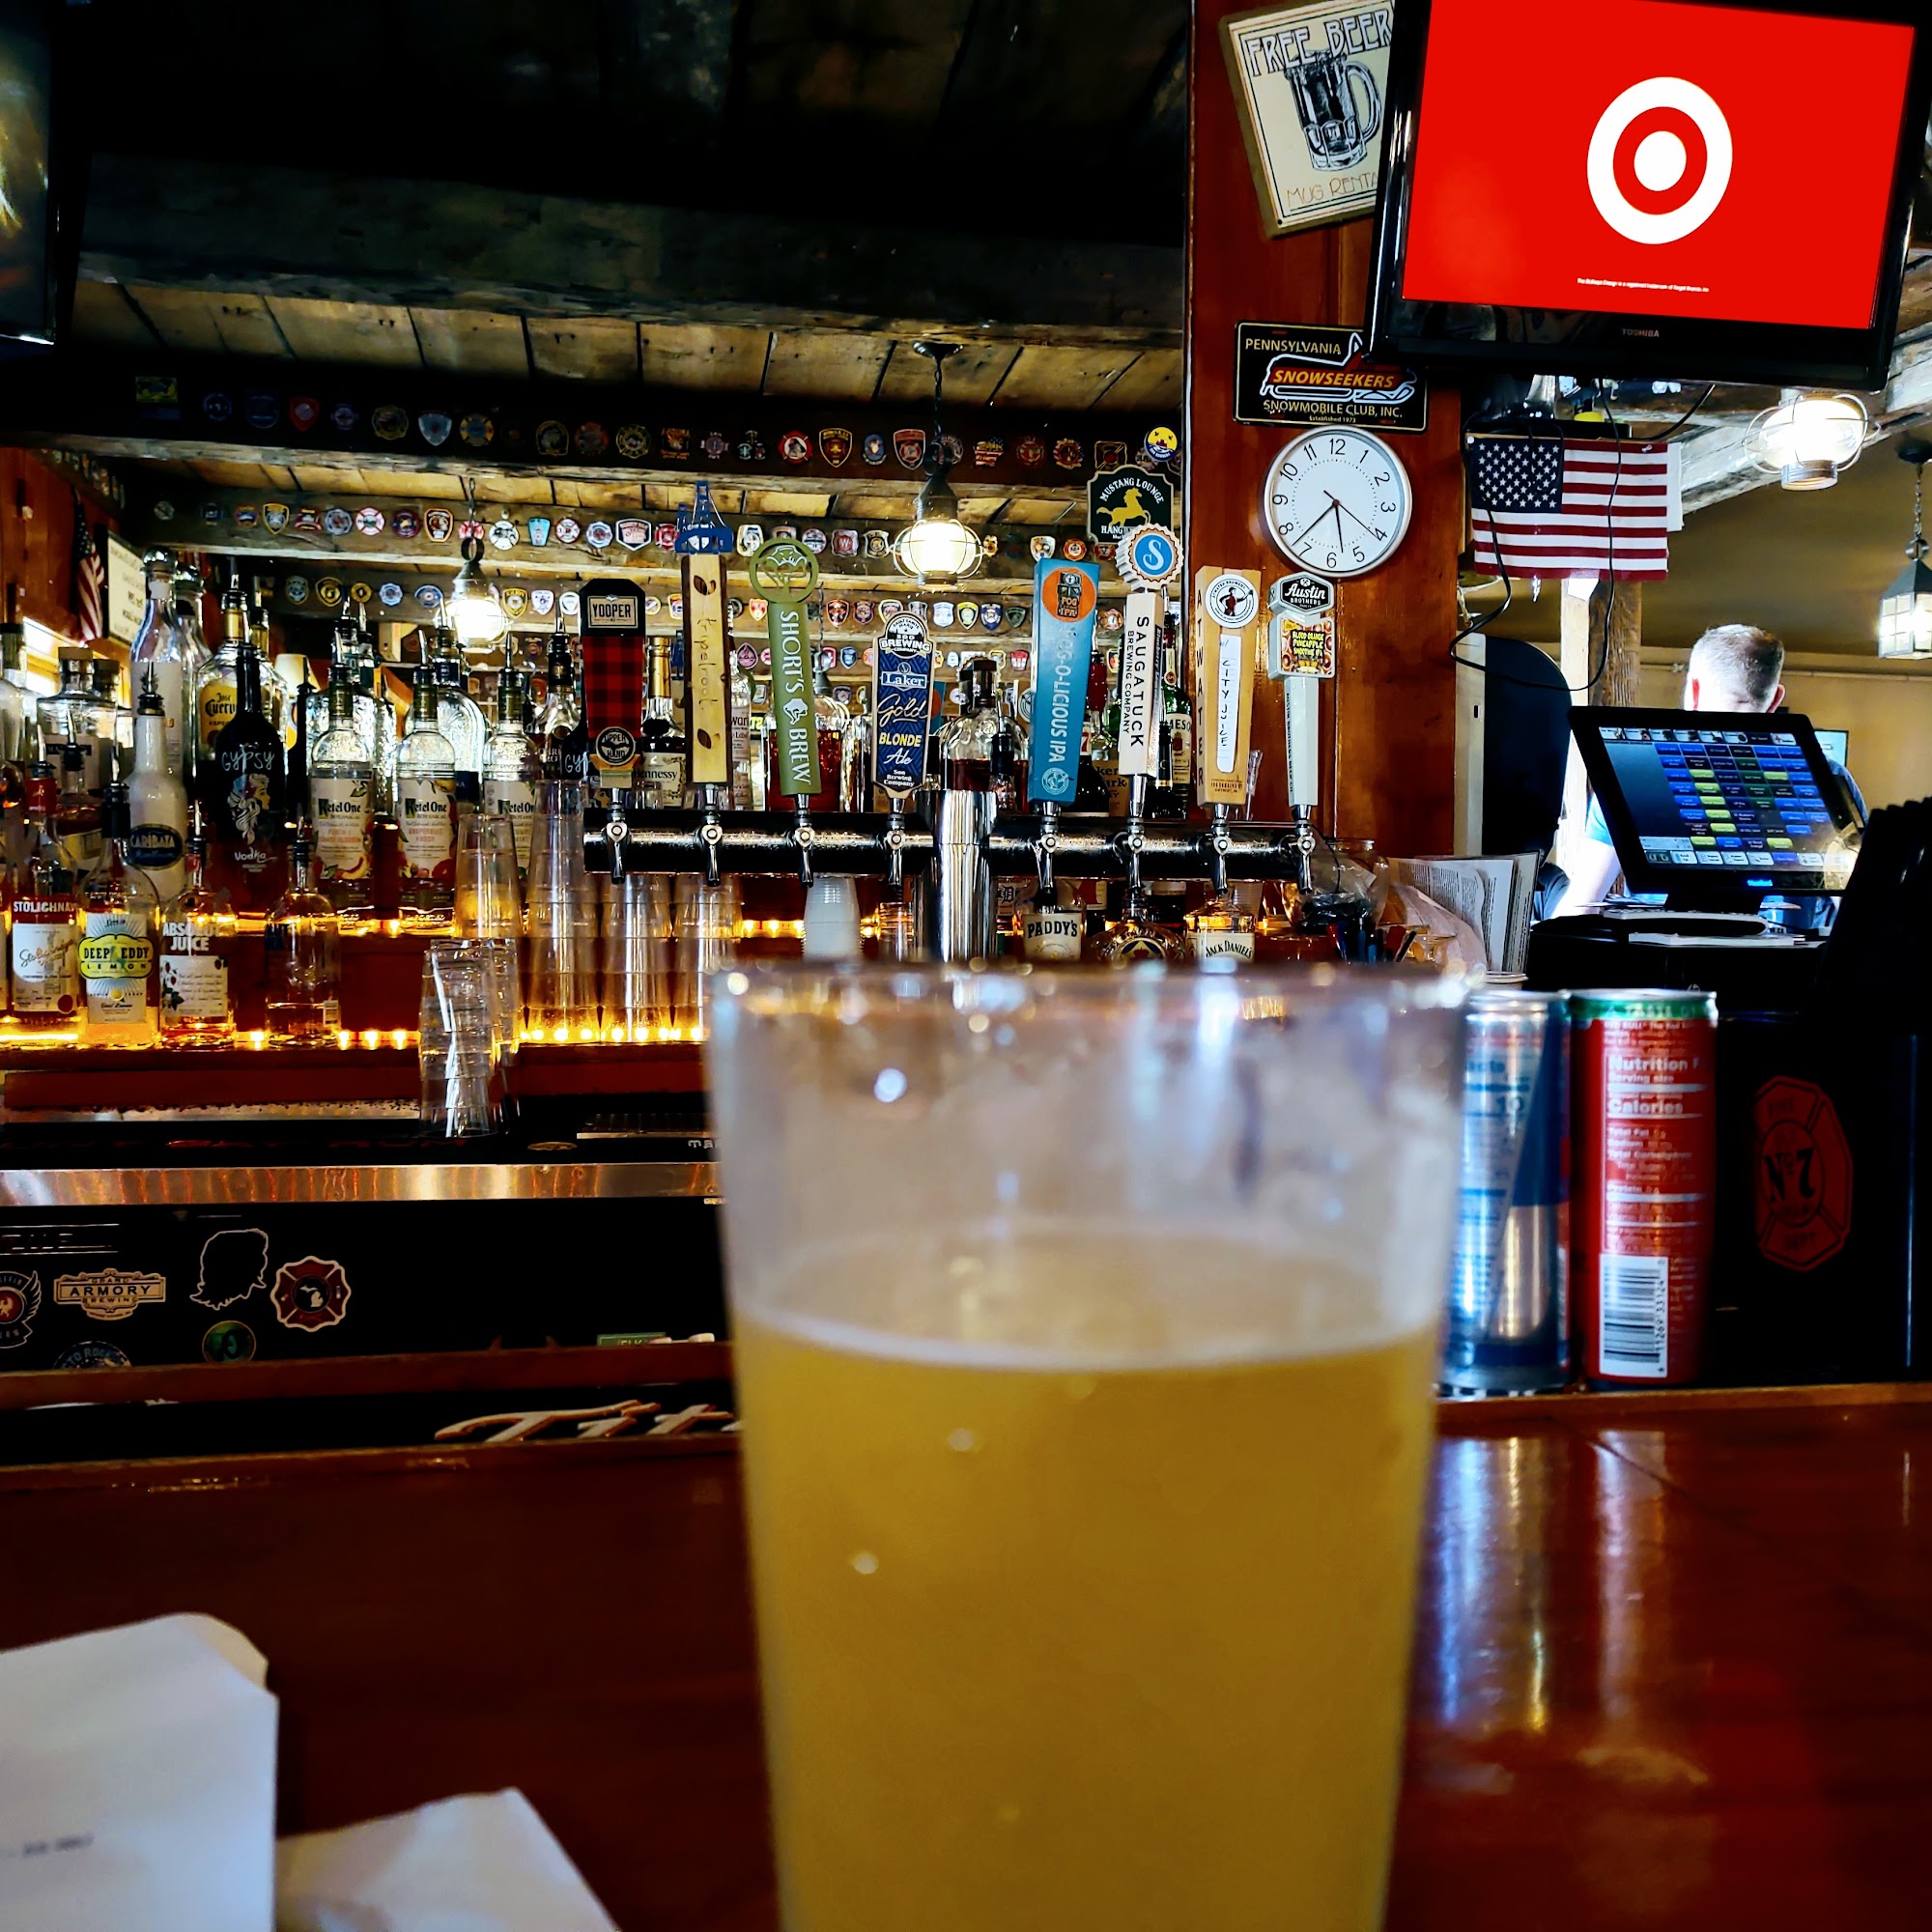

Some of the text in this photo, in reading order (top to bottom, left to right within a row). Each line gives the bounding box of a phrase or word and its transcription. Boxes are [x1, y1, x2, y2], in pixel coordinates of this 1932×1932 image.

[1245, 10, 1392, 76] FREE BEER
[1287, 172, 1378, 208] MUG RENTA
[1622, 327, 1660, 337] TOSHIBA
[1245, 338, 1341, 355] PENNSYLVANIA
[1273, 370, 1395, 387] SNOWSEEKERS
[1264, 400, 1403, 418] SNOWMOBILE CLUB, INC.
[1304, 443, 1318, 461] 11
[1329, 438, 1346, 455] 12
[1360, 450, 1369, 464] 1
[1280, 463, 1298, 481] 10
[1374, 471, 1391, 486] 2
[1099, 477, 1164, 504] MUSTANG LOUNGE
[1272, 495, 1289, 505] 9
[1380, 501, 1397, 513] 3
[1278, 522, 1294, 536] 8
[1375, 527, 1388, 541] 4
[1299, 542, 1312, 556] 7
[1352, 546, 1365, 563] 5
[1326, 553, 1337, 568] 6
[1285, 582, 1325, 600] Austin
[1291, 597, 1321, 606] BROTHERS
[592, 604, 631, 617] YOOPER
[881, 639, 930, 651] BREWING
[885, 674, 924, 688] Laker
[1122, 631, 1134, 734] BREWING COMPANY
[1130, 616, 1150, 747] SAUGATUCK
[781, 611, 810, 785] SHORT'S BREW
[877, 694, 927, 726] Gold
[879, 732, 922, 747] BLONDE
[884, 748, 913, 765] Ale
[1048, 740, 1065, 762] IPA
[884, 779, 915, 787] Company
[319, 798, 361, 817] Ketel One
[406, 798, 447, 817] Ketel One
[234, 847, 277, 863] Vodka
[1028, 920, 1077, 939] PADDY'S
[170, 937, 210, 951] JUICE
[1206, 940, 1253, 959] JACK DANIEL'S
[84, 948, 110, 959] DEEP
[121, 948, 149, 959] EDDY
[1609, 1055, 1688, 1071] Nutrition
[1608, 1098, 1683, 1113] Calories
[71, 1286, 151, 1296] ARMORY
